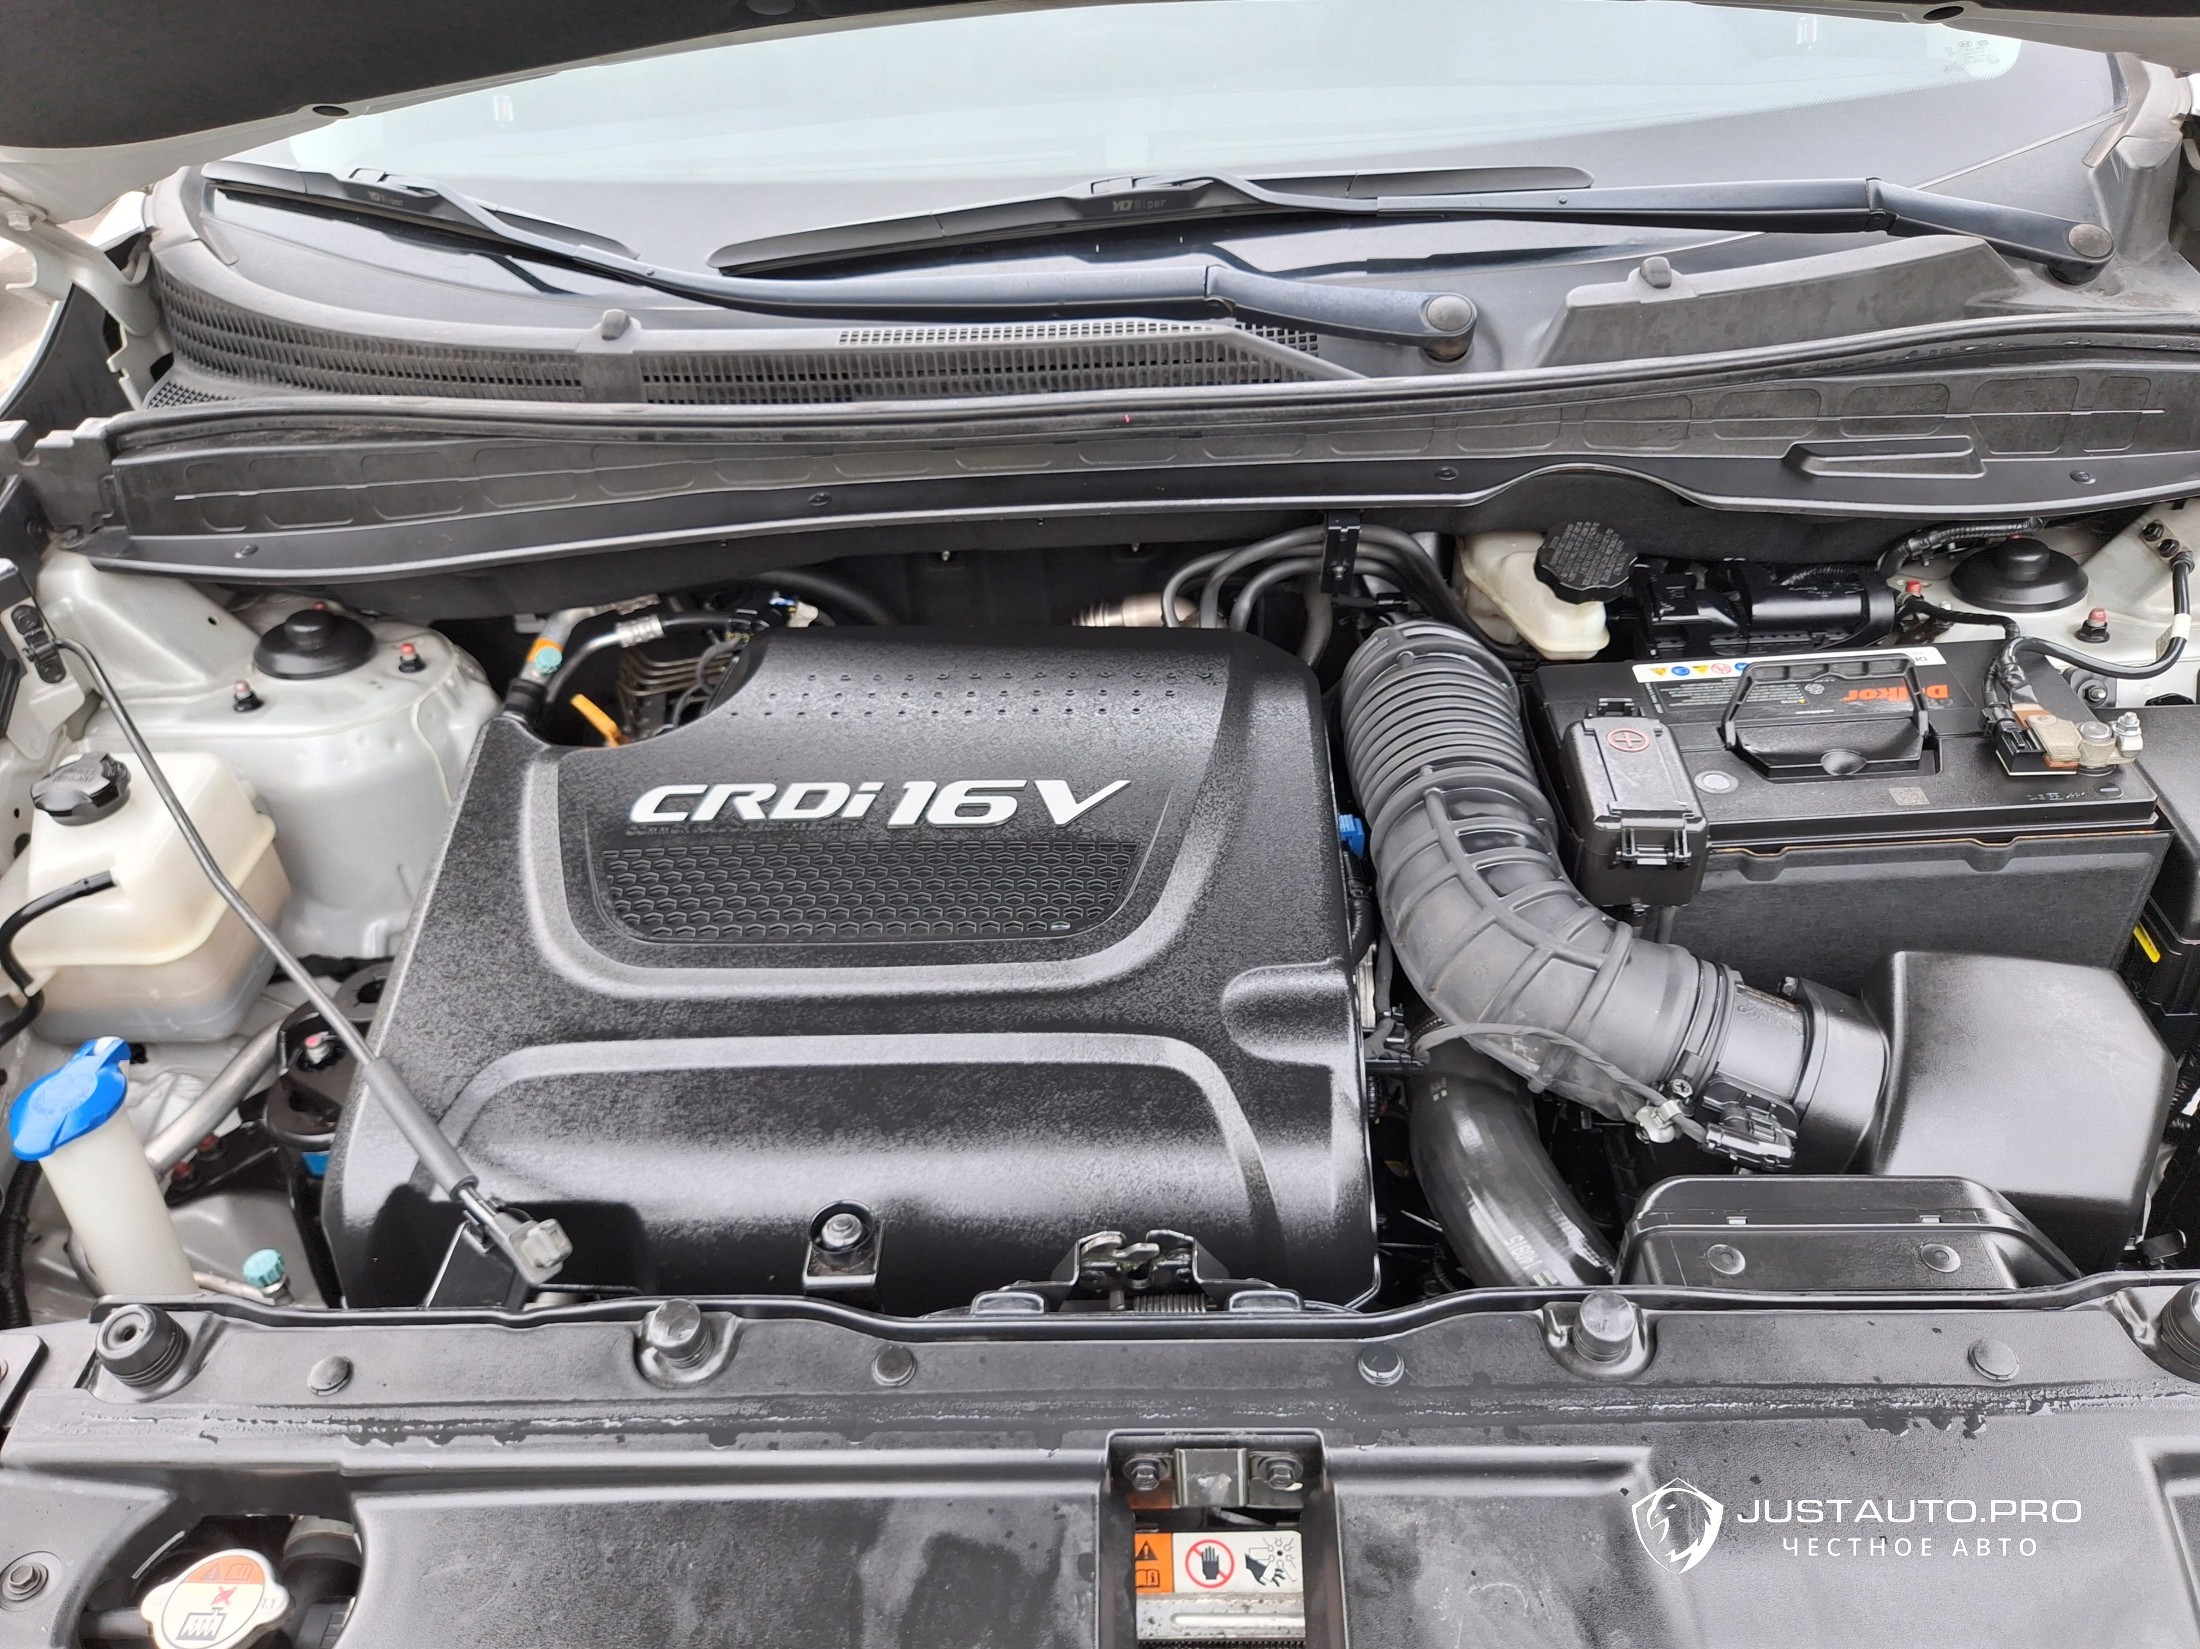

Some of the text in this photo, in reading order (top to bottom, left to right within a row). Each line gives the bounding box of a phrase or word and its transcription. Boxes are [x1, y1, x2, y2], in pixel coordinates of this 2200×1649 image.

[1843, 685, 1949, 702] Dlkor
[629, 778, 1131, 829] CRDi 16V
[1503, 1234, 1543, 1270] 140915
